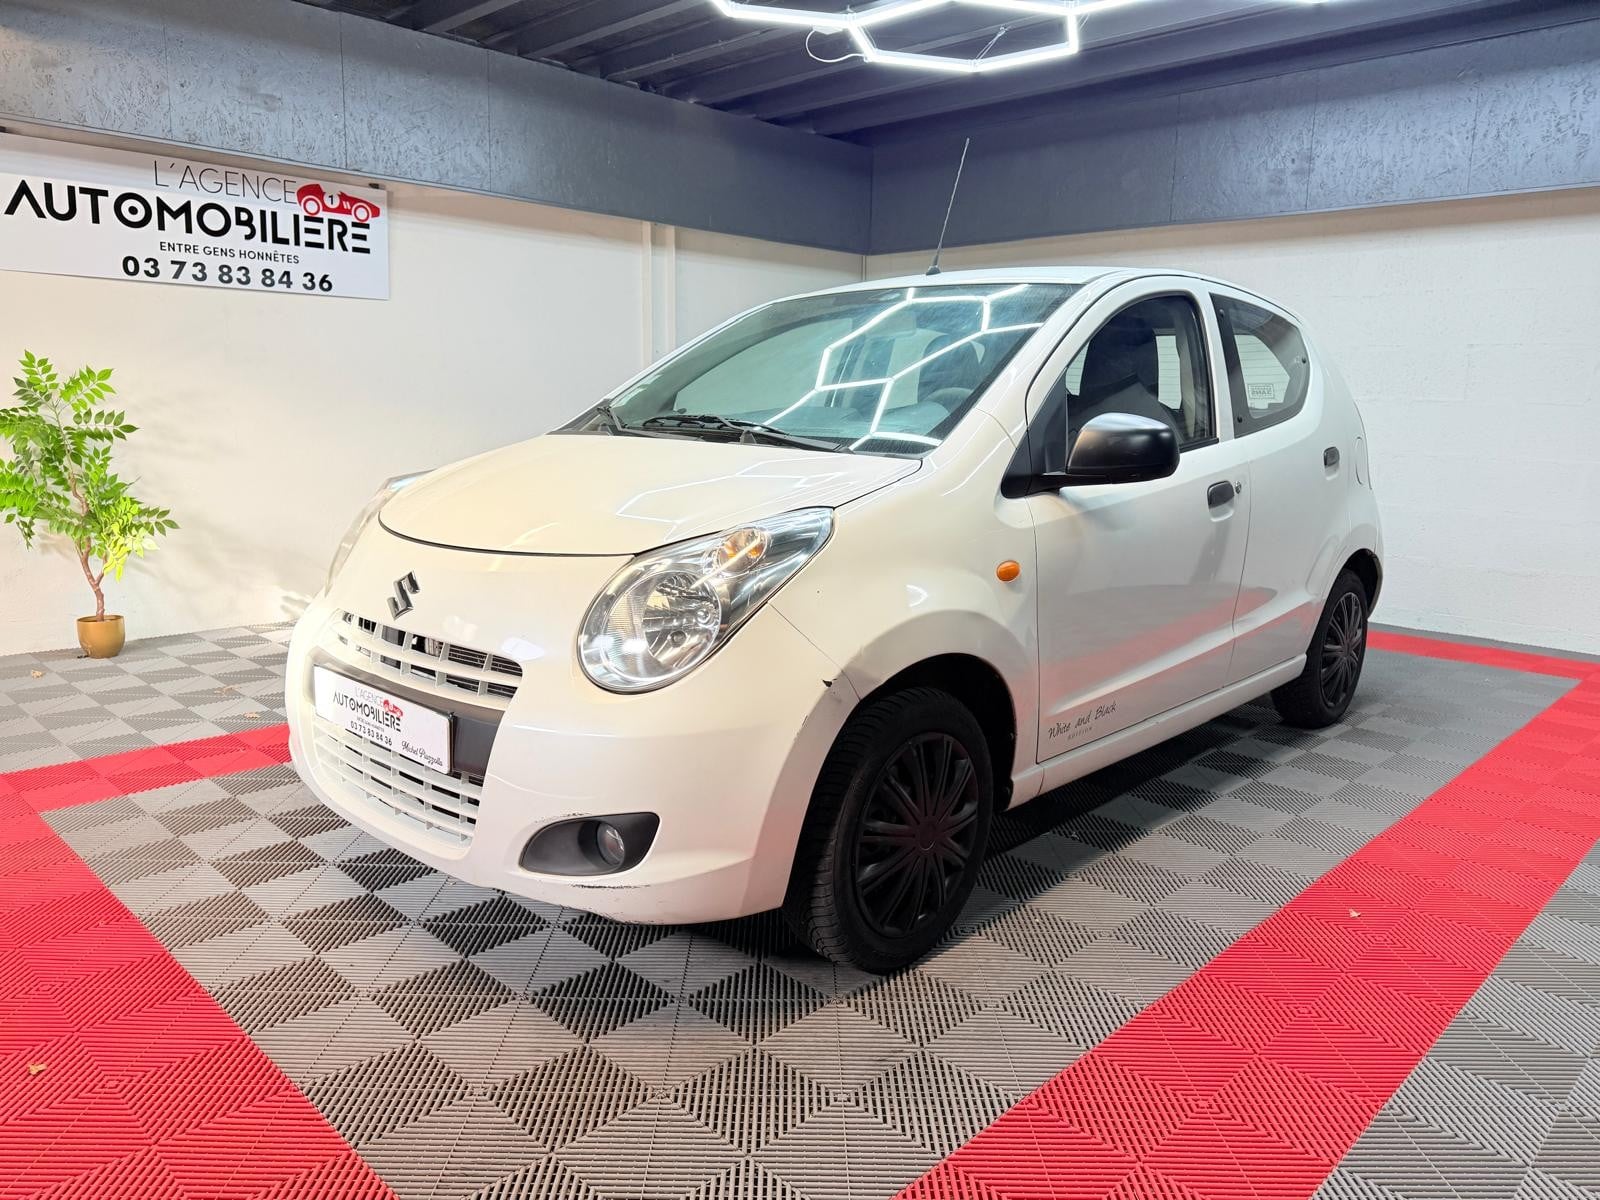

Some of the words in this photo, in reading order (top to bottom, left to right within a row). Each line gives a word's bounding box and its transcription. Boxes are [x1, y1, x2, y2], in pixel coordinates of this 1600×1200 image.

[153, 160, 297, 205] L'AGENCE
[3, 179, 371, 255] AUTOMOBILIERE
[159, 241, 200, 255] ENTRE
[203, 246, 236, 259] GENS
[239, 249, 300, 265] HONNÊTES
[122, 256, 161, 279] 03
[170, 260, 208, 282] 73
[218, 264, 251, 286] 83
[261, 268, 293, 289] 84
[302, 271, 333, 293] 36
[1048, 722, 1071, 739] White
[1074, 710, 1093, 728] and
[1094, 700, 1117, 720] Black
